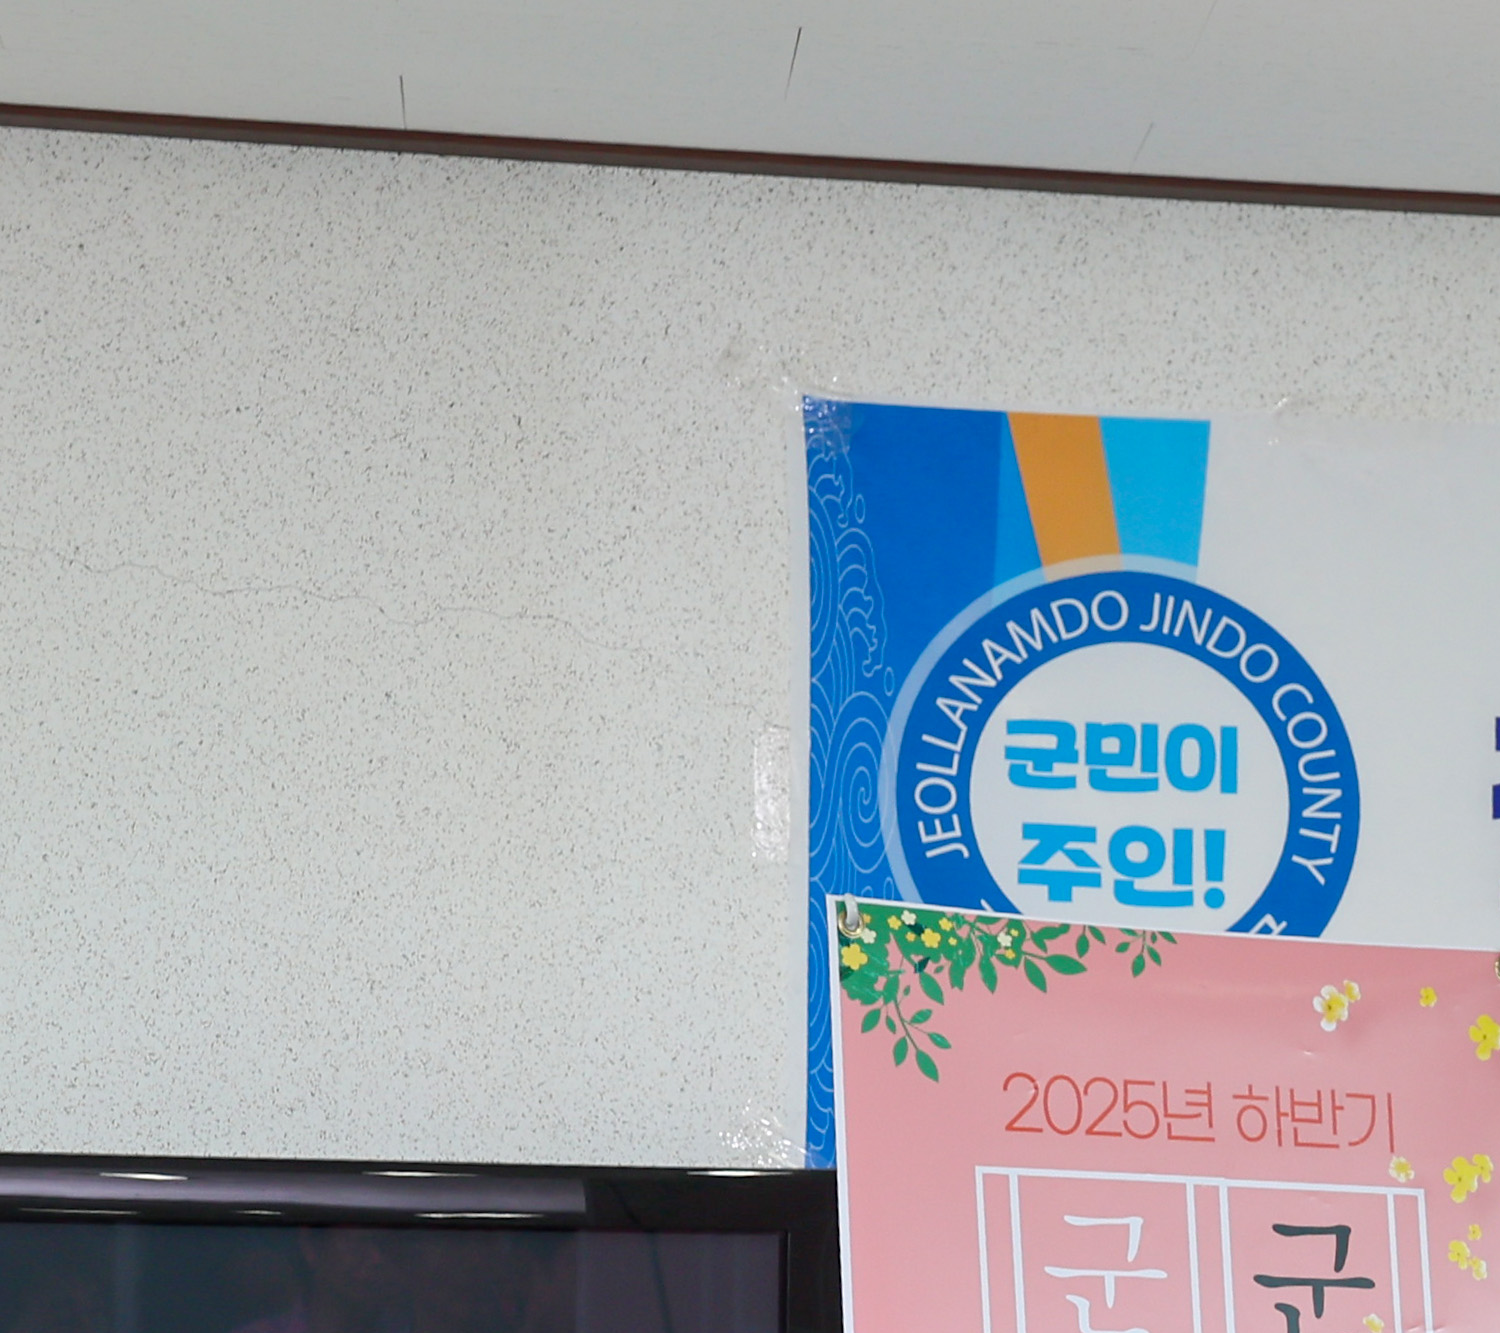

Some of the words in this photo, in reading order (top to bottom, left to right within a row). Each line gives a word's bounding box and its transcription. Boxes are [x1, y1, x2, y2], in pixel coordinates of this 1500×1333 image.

[914, 590, 1129, 859] JEOLLANAMDO
[1140, 592, 1279, 683] JINDO
[1271, 682, 1343, 886] COUNTY
[1004, 719, 1238, 794] 군민이
[1017, 823, 1226, 909] 주인!
[1002, 1072, 1217, 1143] 2025년
[1231, 1082, 1397, 1154] 하반기
